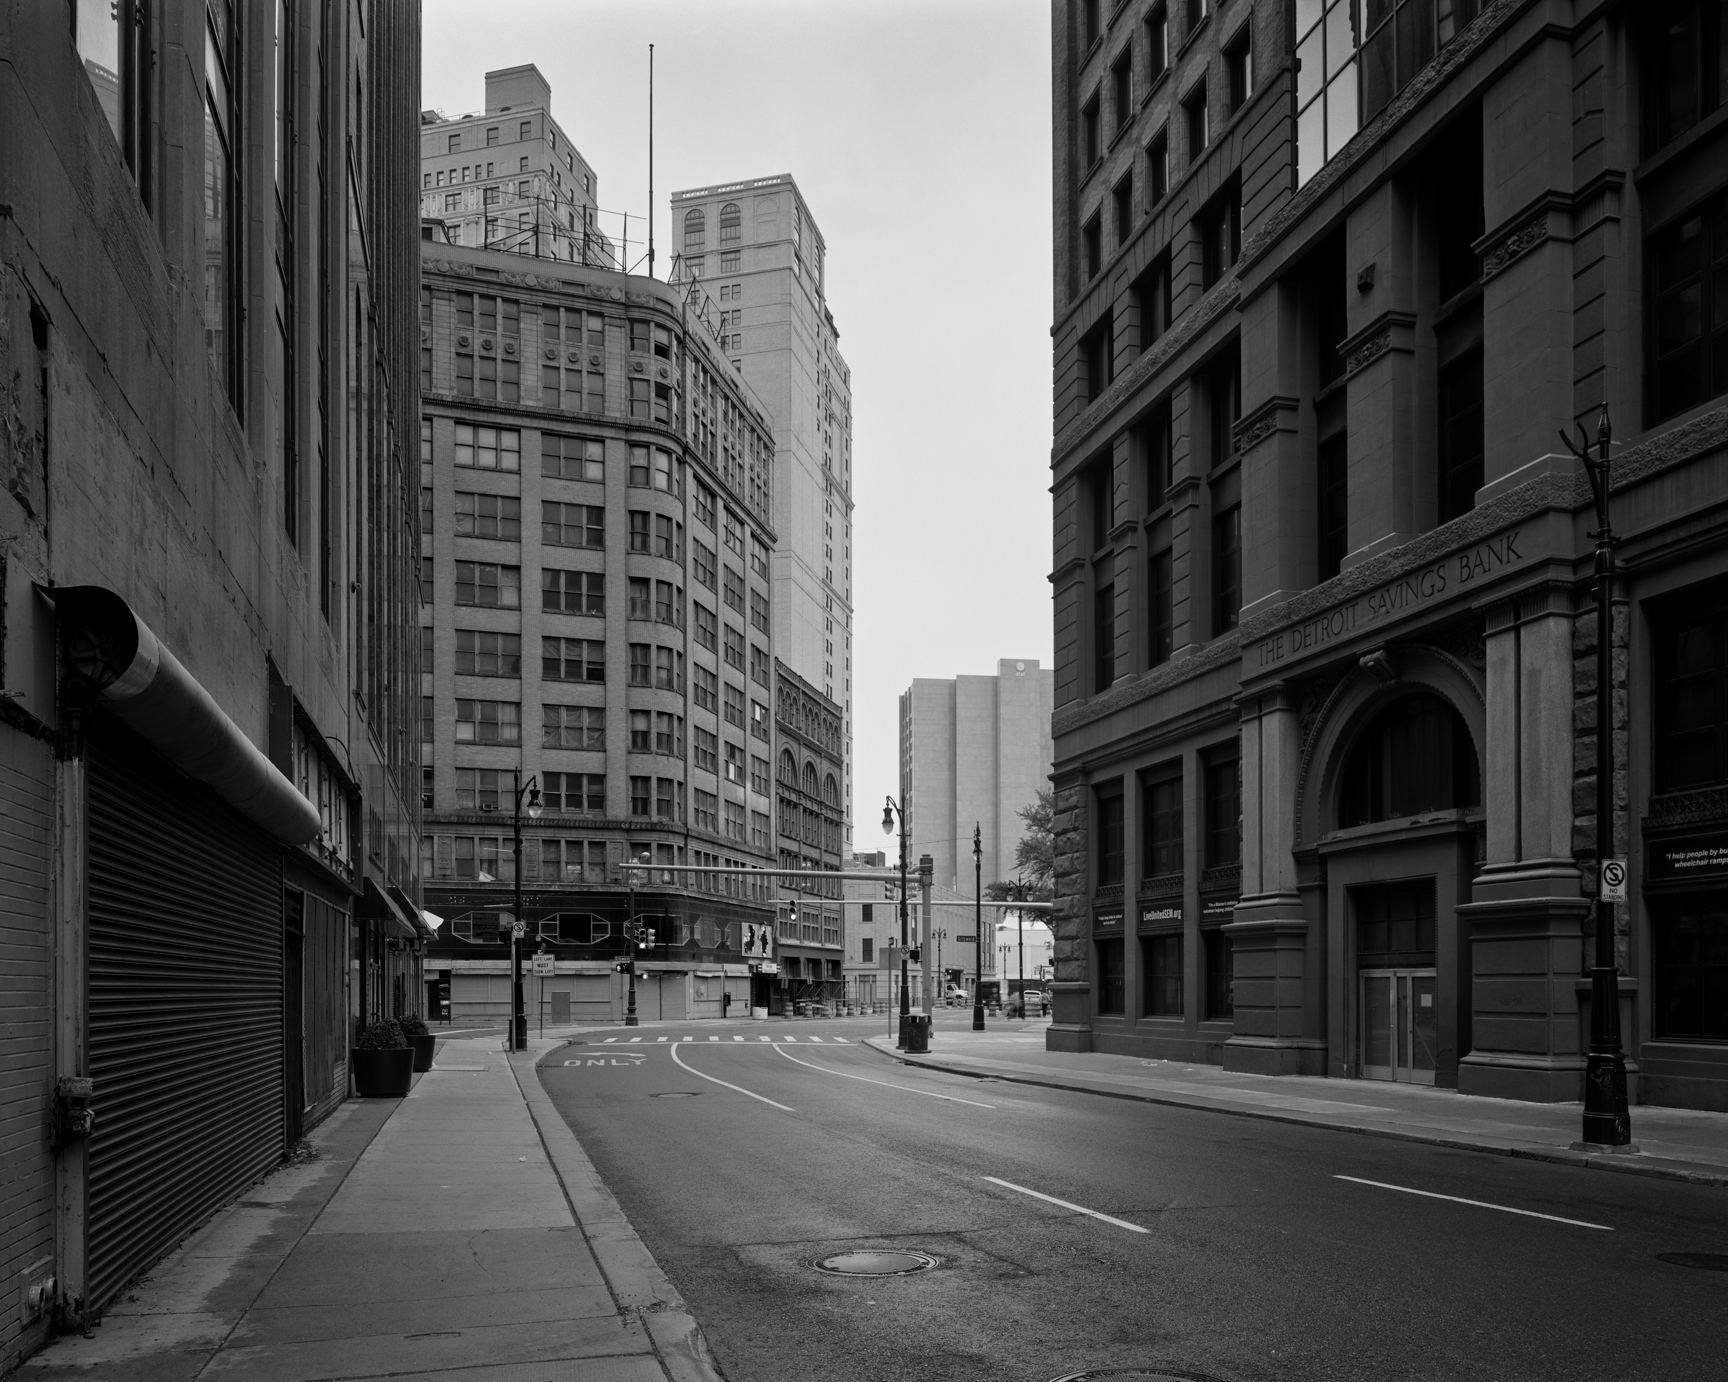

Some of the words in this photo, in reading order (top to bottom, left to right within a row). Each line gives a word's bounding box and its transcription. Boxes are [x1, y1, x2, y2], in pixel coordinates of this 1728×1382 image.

[1257, 636, 1284, 667] THE
[1291, 602, 1358, 654] DETROIT
[1367, 565, 1446, 623] SAVINGS
[1458, 531, 1523, 585] BANK
[1671, 851, 1686, 860] help
[1686, 849, 1709, 860] people
[1709, 848, 1719, 857] by
[1674, 858, 1710, 868] wheelchair
[563, 1058, 647, 1067] ONLY
